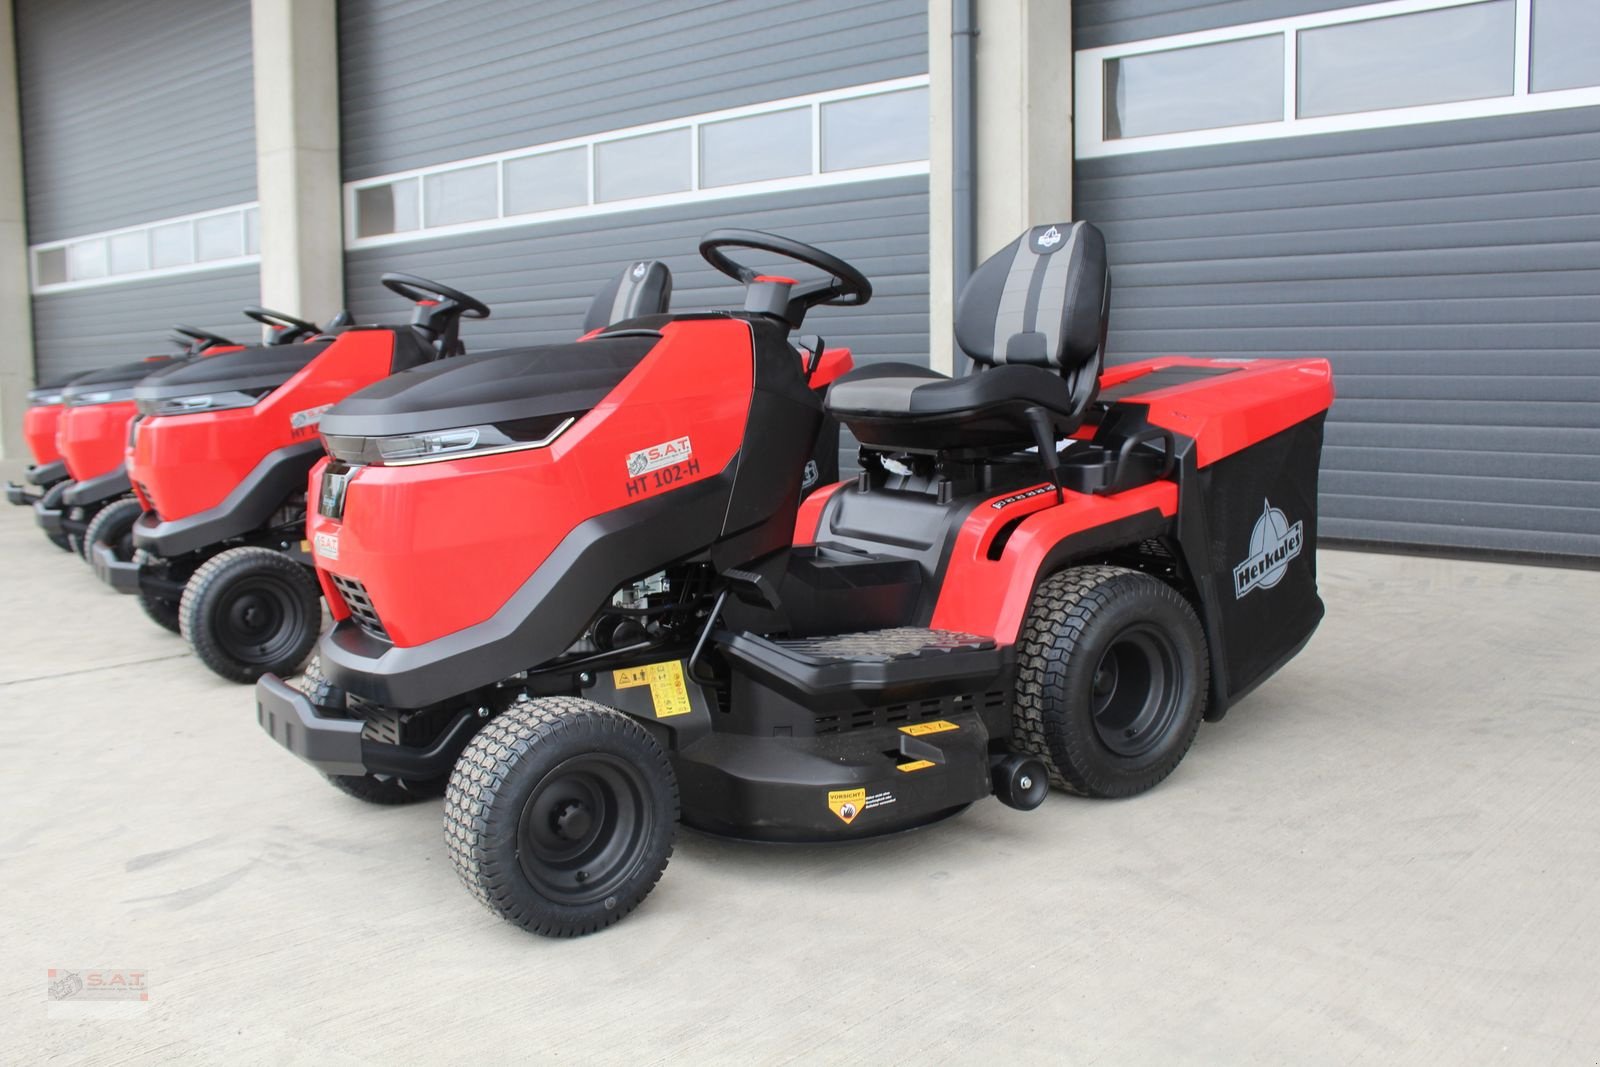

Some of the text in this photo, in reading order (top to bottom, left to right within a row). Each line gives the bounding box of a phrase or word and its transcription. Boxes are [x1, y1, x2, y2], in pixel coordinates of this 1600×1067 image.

[626, 458, 700, 497] HT 102-H
[1238, 531, 1300, 589] Herkules
